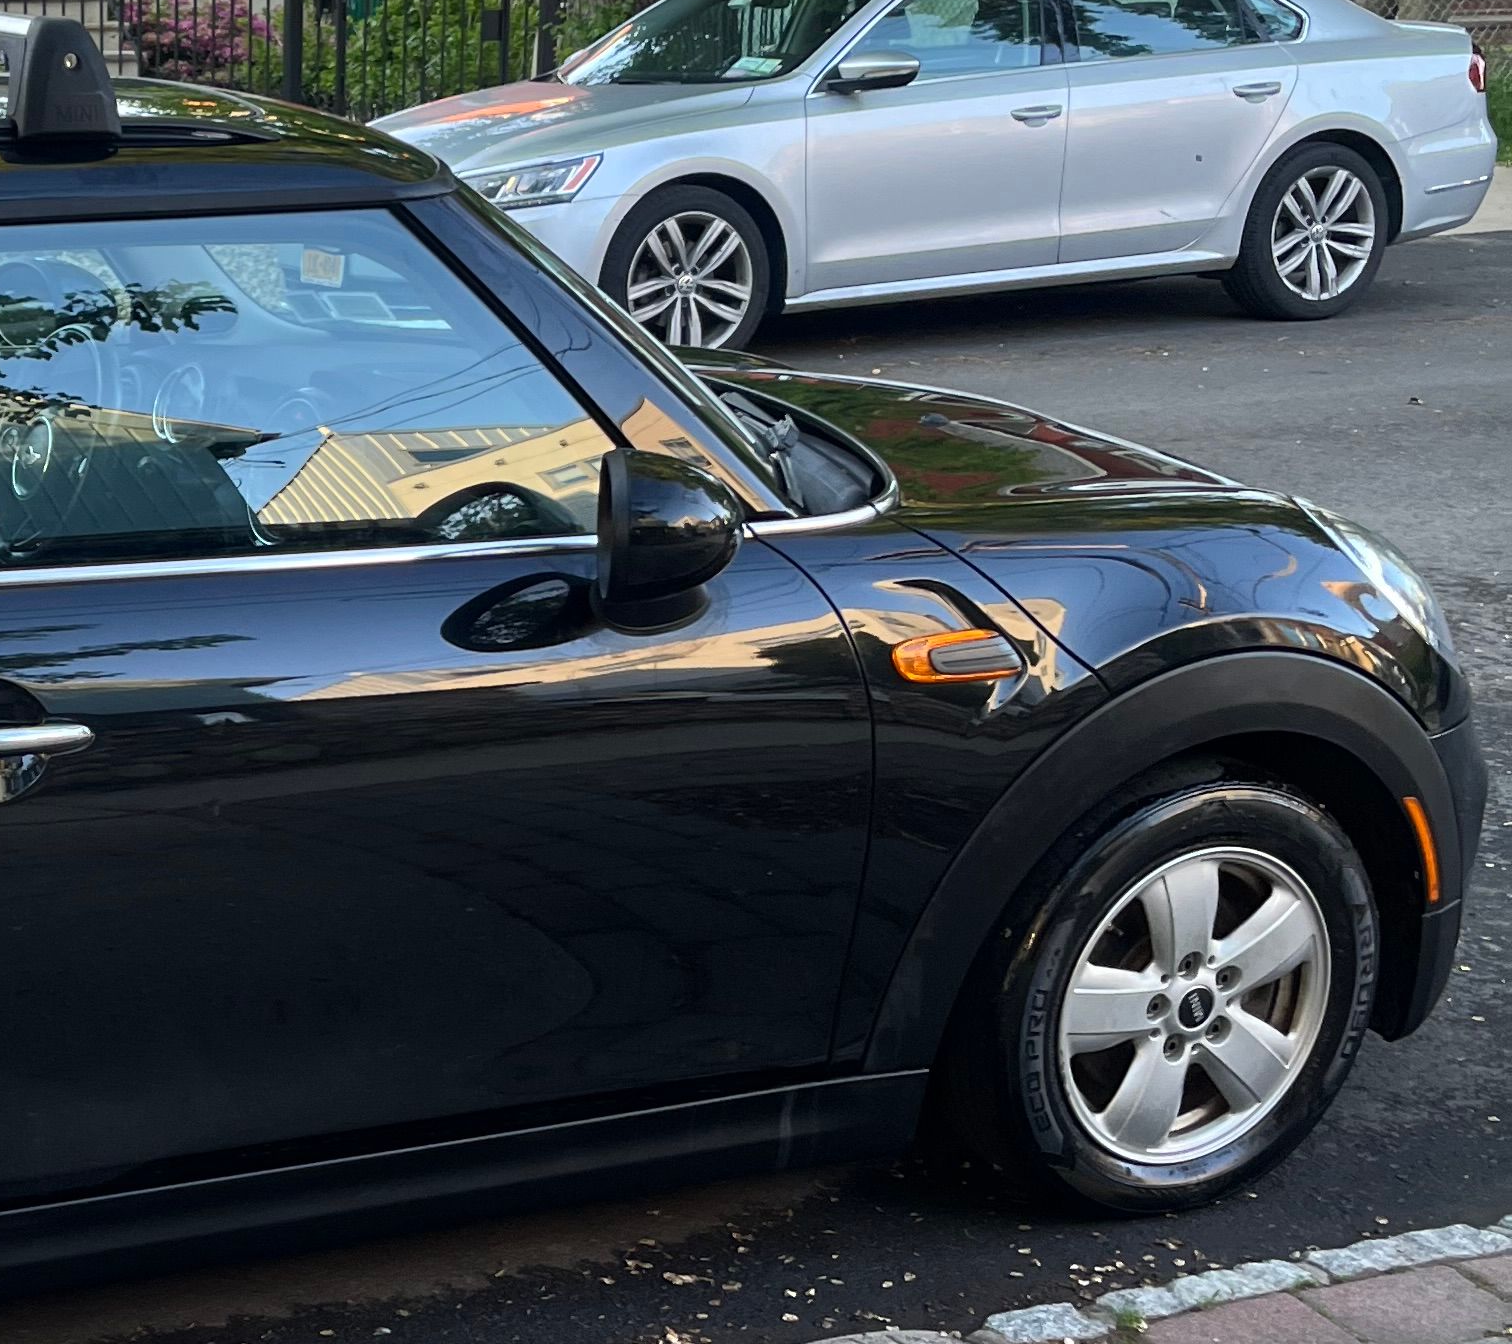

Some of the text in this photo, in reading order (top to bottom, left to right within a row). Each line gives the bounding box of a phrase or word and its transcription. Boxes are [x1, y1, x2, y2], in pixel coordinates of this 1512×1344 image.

[55, 103, 99, 122] MINI
[1025, 989, 1048, 1059] PRO
[1188, 992, 1205, 1023] MINI
[1025, 1071, 1052, 1133] ECO
